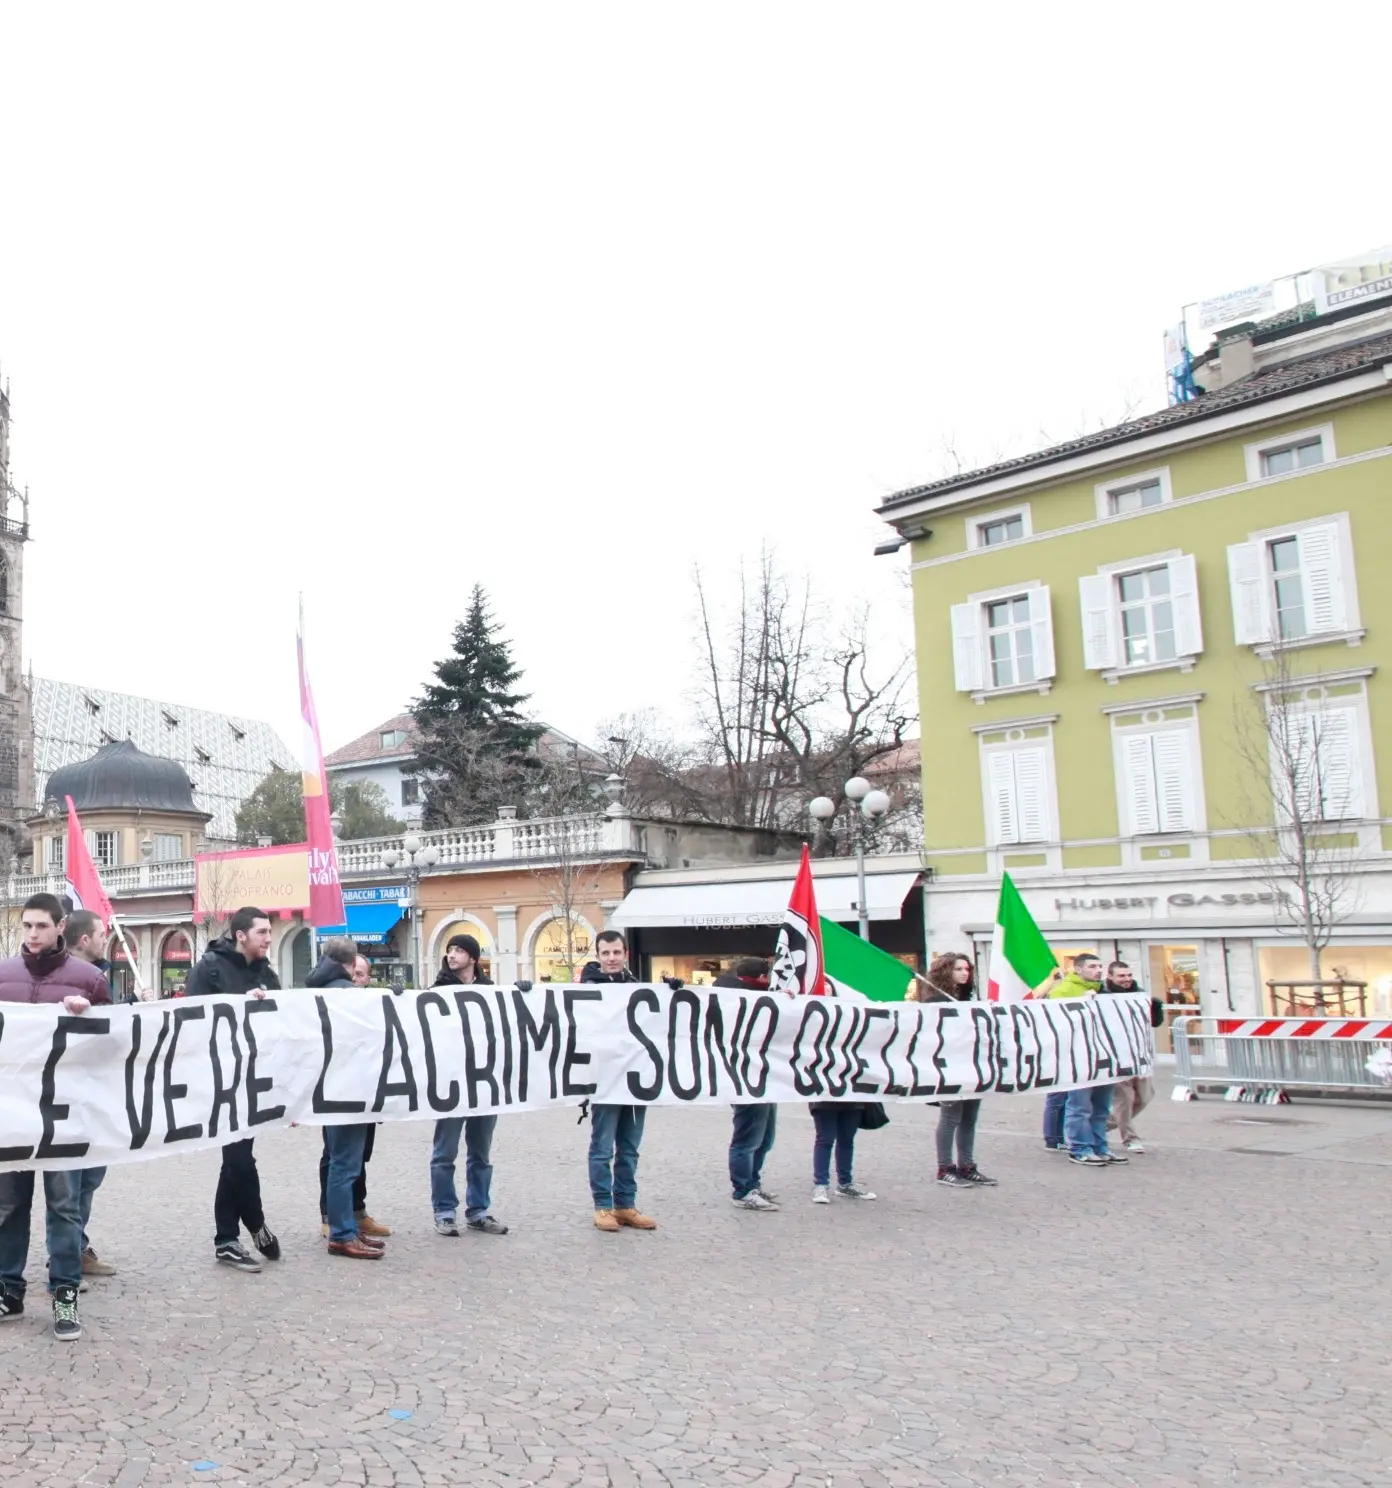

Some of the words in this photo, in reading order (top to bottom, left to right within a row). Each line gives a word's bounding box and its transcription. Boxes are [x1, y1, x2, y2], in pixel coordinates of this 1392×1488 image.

[308, 847, 330, 873] ily
[233, 867, 272, 881] PALAIS
[343, 890, 377, 901] ABACCHI
[1054, 896, 1158, 912] HUBERT
[1167, 891, 1292, 908] GASSER
[683, 915, 737, 925] HUBERT
[746, 914, 785, 924] GASS
[124, 999, 286, 1150] VERE
[311, 989, 603, 1113] LACRIME
[626, 988, 780, 1101] SONO
[789, 1000, 962, 1097] QUELLE
[971, 1003, 1060, 1093] DEGLI
